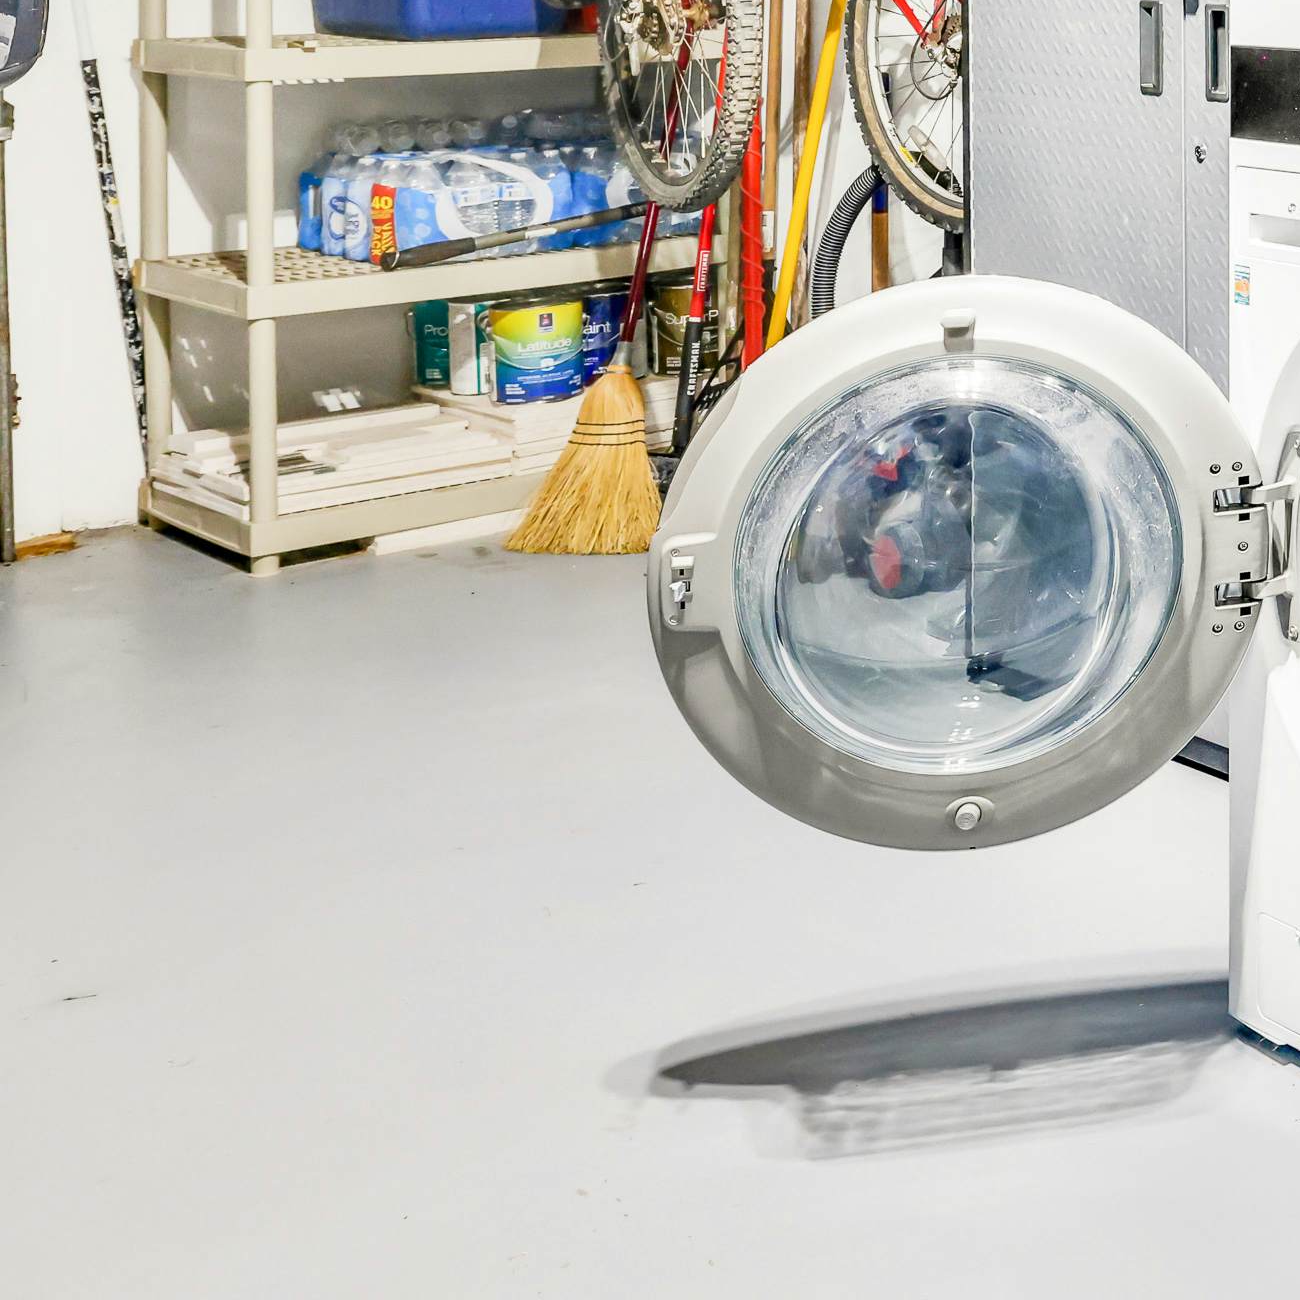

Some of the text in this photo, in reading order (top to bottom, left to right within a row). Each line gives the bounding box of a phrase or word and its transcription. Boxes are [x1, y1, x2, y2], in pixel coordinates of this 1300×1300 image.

[371, 196, 393, 209] 40
[424, 324, 448, 337] Pro
[583, 322, 611, 334] aint
[518, 338, 572, 352] Latitude
[687, 341, 700, 396] CRAFTSMAN
